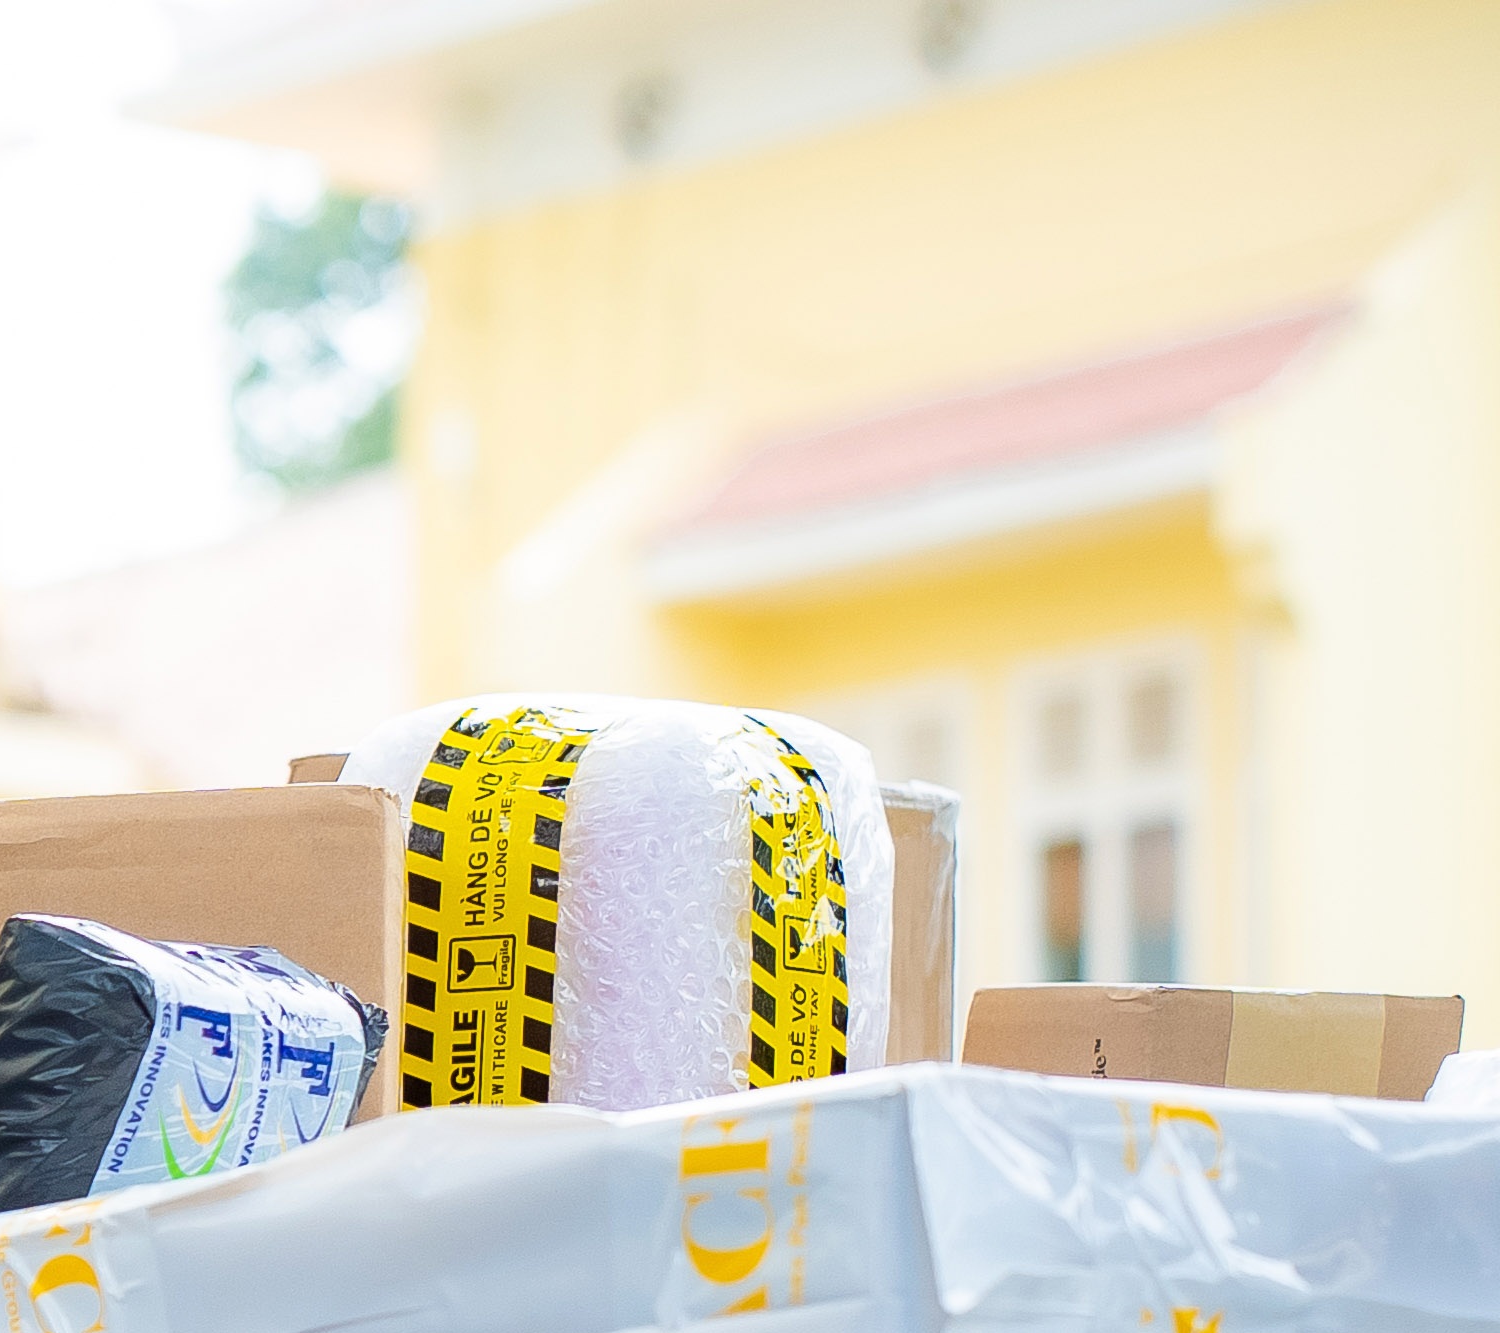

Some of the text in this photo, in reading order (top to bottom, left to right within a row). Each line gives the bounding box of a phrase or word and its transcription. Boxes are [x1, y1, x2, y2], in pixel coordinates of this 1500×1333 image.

[467, 808, 493, 842] DỄ
[492, 839, 509, 889] LÒNG
[460, 852, 489, 926] HÀNG
[493, 893, 507, 922] VUI
[498, 939, 511, 985] Fragile
[790, 983, 807, 1023] VỠ
[811, 988, 819, 1019] TAY
[809, 1025, 820, 1061] NHẸ
[107, 1045, 167, 1173] INNOVATION
